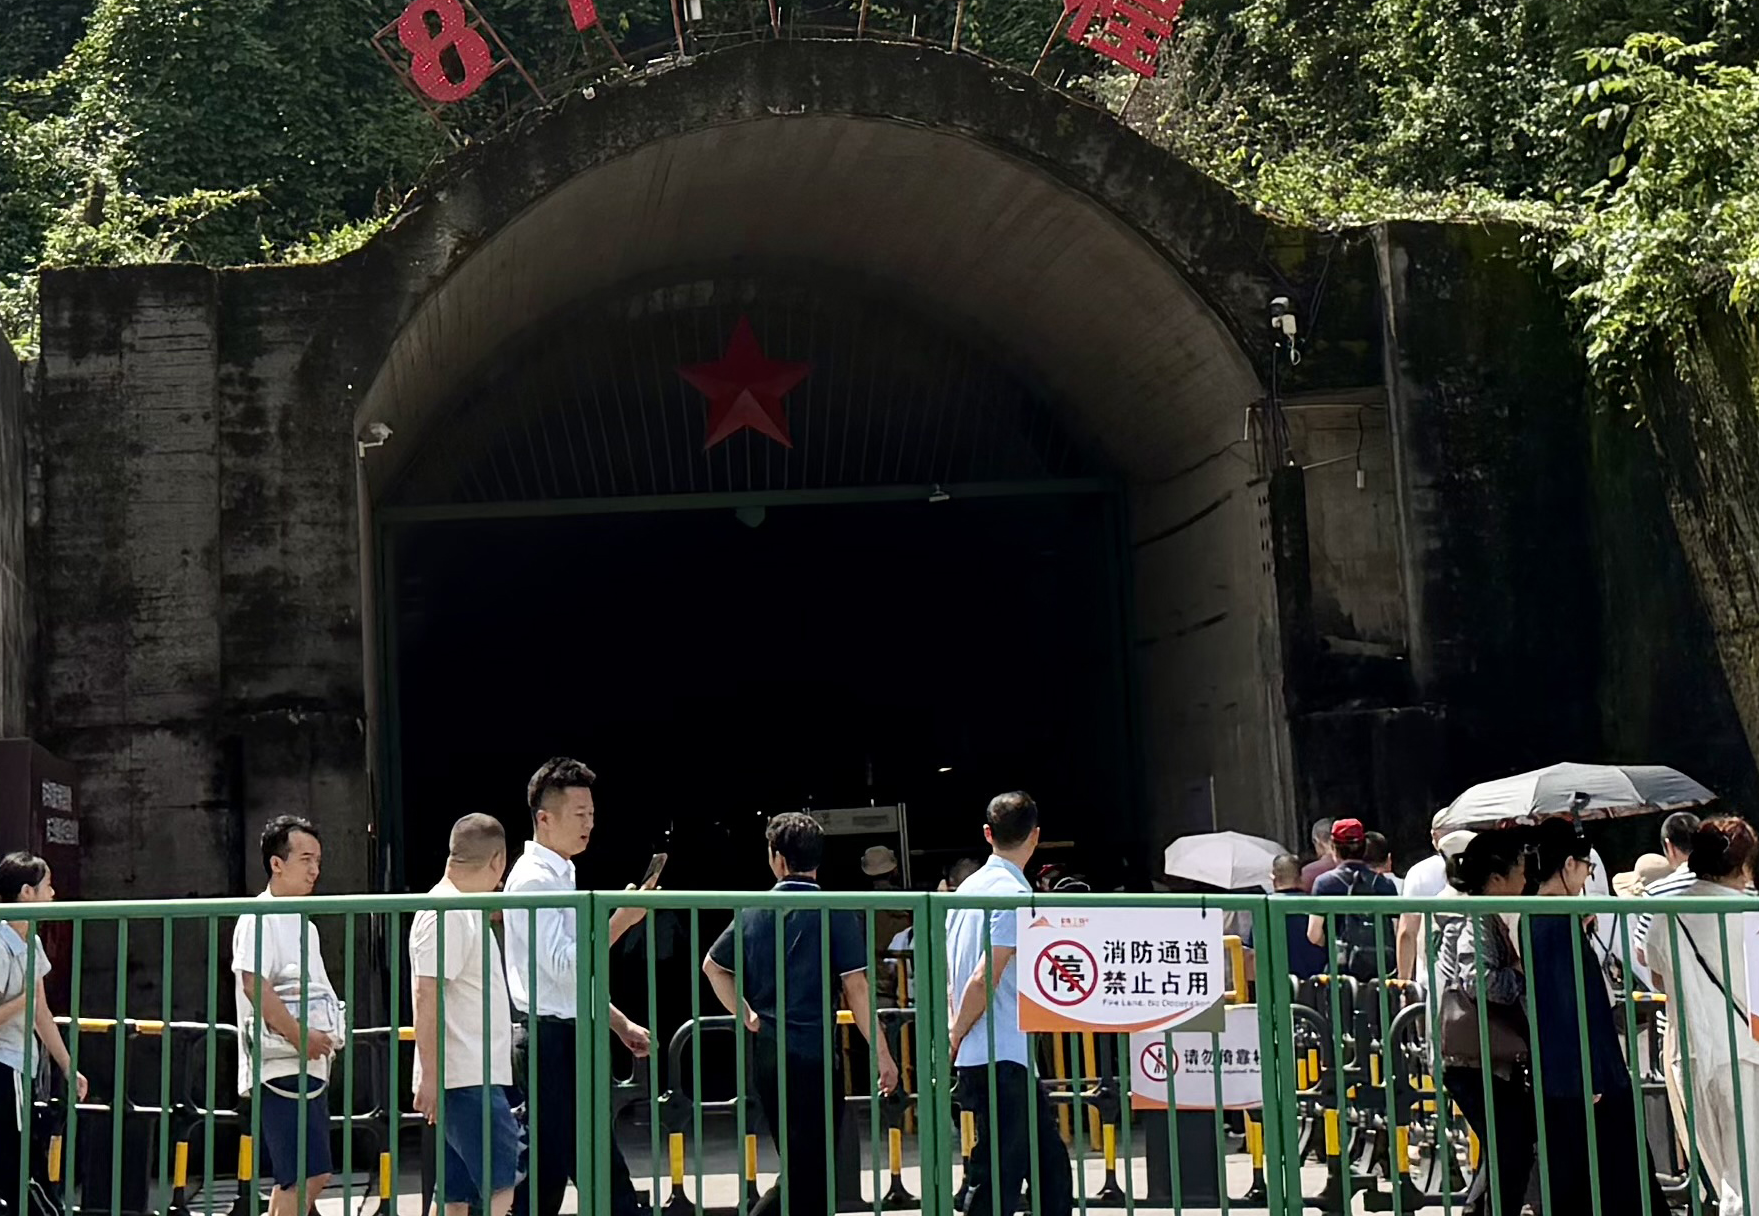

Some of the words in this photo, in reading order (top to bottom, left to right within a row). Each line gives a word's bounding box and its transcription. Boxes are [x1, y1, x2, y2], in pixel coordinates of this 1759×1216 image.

[1102, 940, 1210, 965] 消防通道
[1048, 954, 1086, 992] 停
[1102, 971, 1209, 995] 禁止占用
